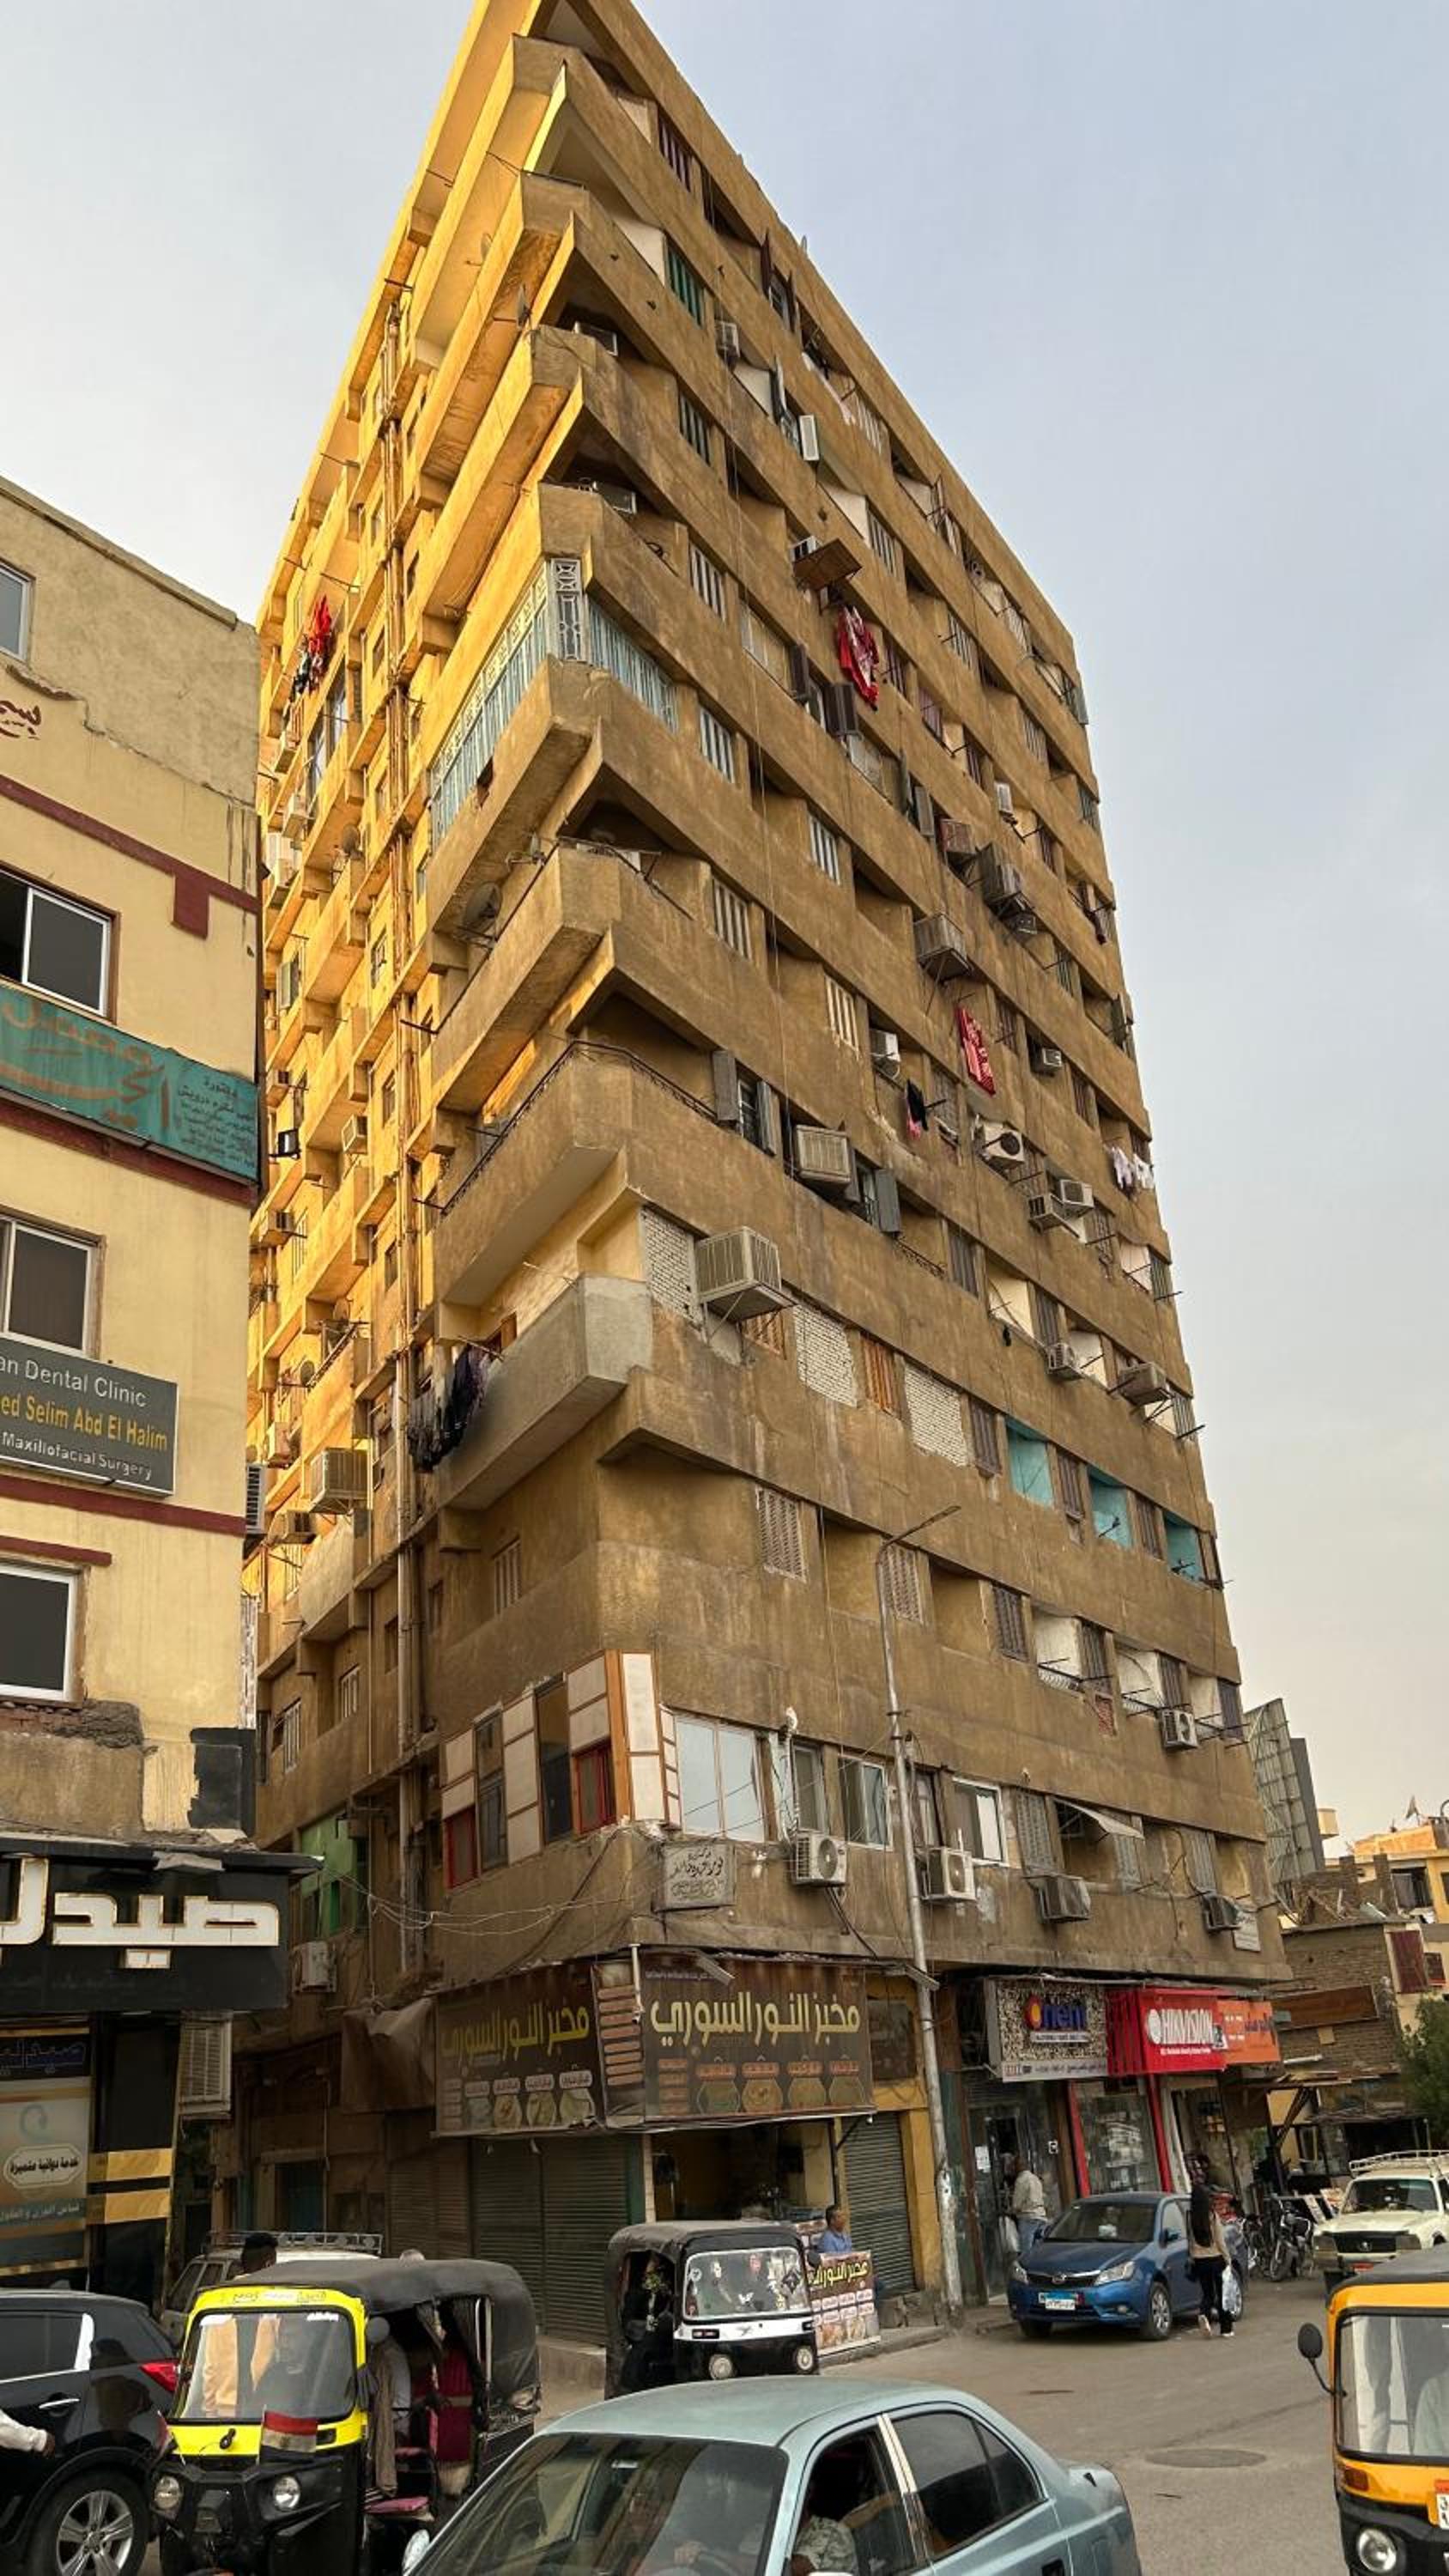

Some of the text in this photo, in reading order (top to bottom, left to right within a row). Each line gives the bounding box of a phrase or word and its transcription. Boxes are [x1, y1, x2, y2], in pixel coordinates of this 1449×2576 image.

[25, 1359, 88, 1392] Dental
[94, 1377, 147, 1407] Clinic
[27, 1395, 69, 1430] Selim
[74, 1406, 102, 1436] Abd
[108, 1414, 121, 1442] El
[126, 1419, 168, 1452] Halim
[2, 1431, 152, 1481] Maxillofacial Surgery
[651, 1991, 754, 2047] السوري
[754, 1992, 811, 2046] النور
[812, 1994, 861, 2046] مخبز
[1160, 2008, 1215, 2045] HIKVISION
[846, 2262, 869, 2284] مخبز
